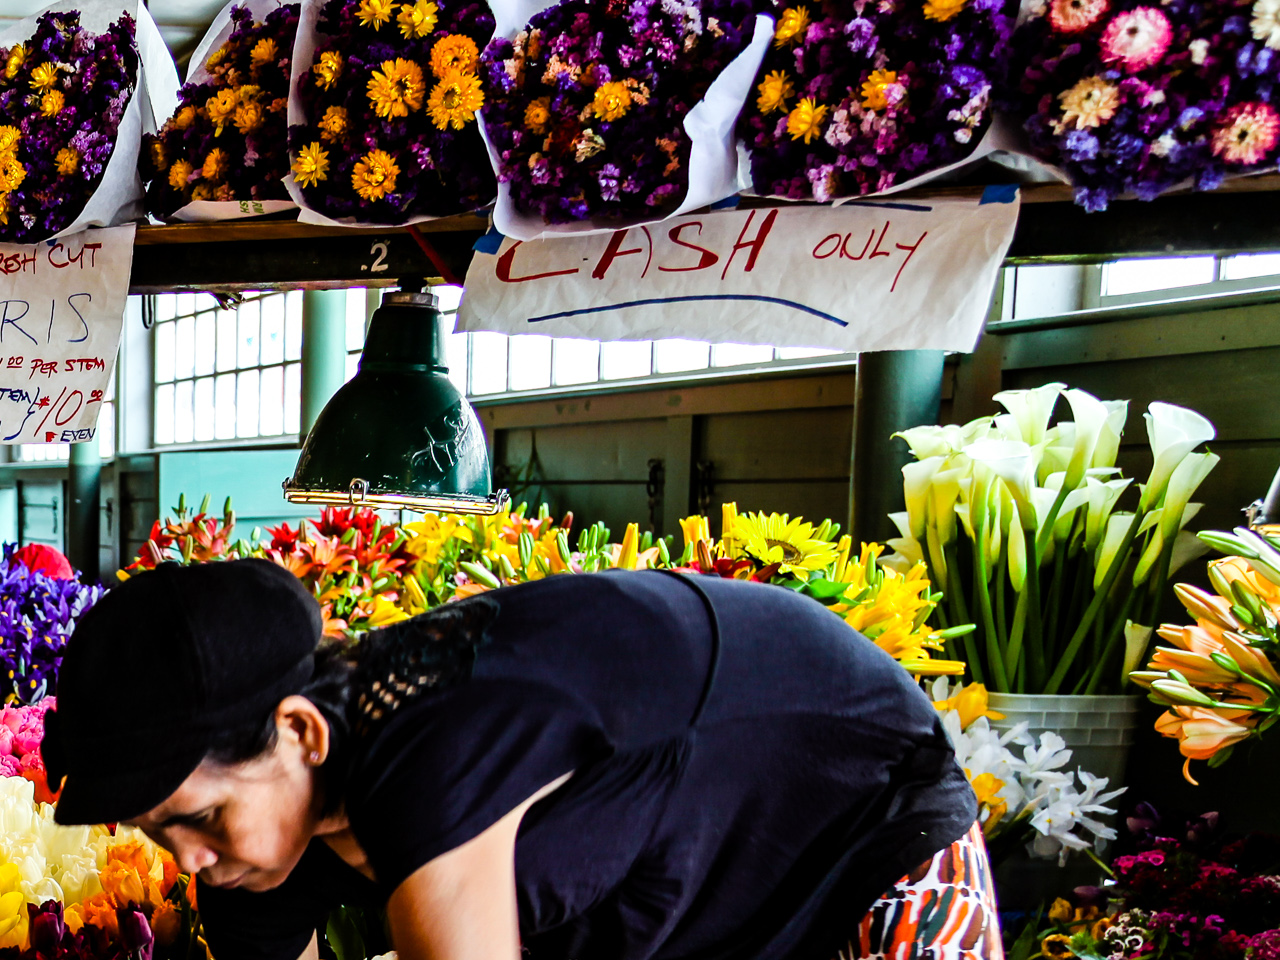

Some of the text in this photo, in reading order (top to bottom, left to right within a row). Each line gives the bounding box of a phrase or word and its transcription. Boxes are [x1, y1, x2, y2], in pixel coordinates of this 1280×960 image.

[48, 242, 102, 269] CUT
[495, 209, 927, 292] CASH ONLY
[29, 359, 59, 380] PER
[64, 357, 105, 373] STEM
